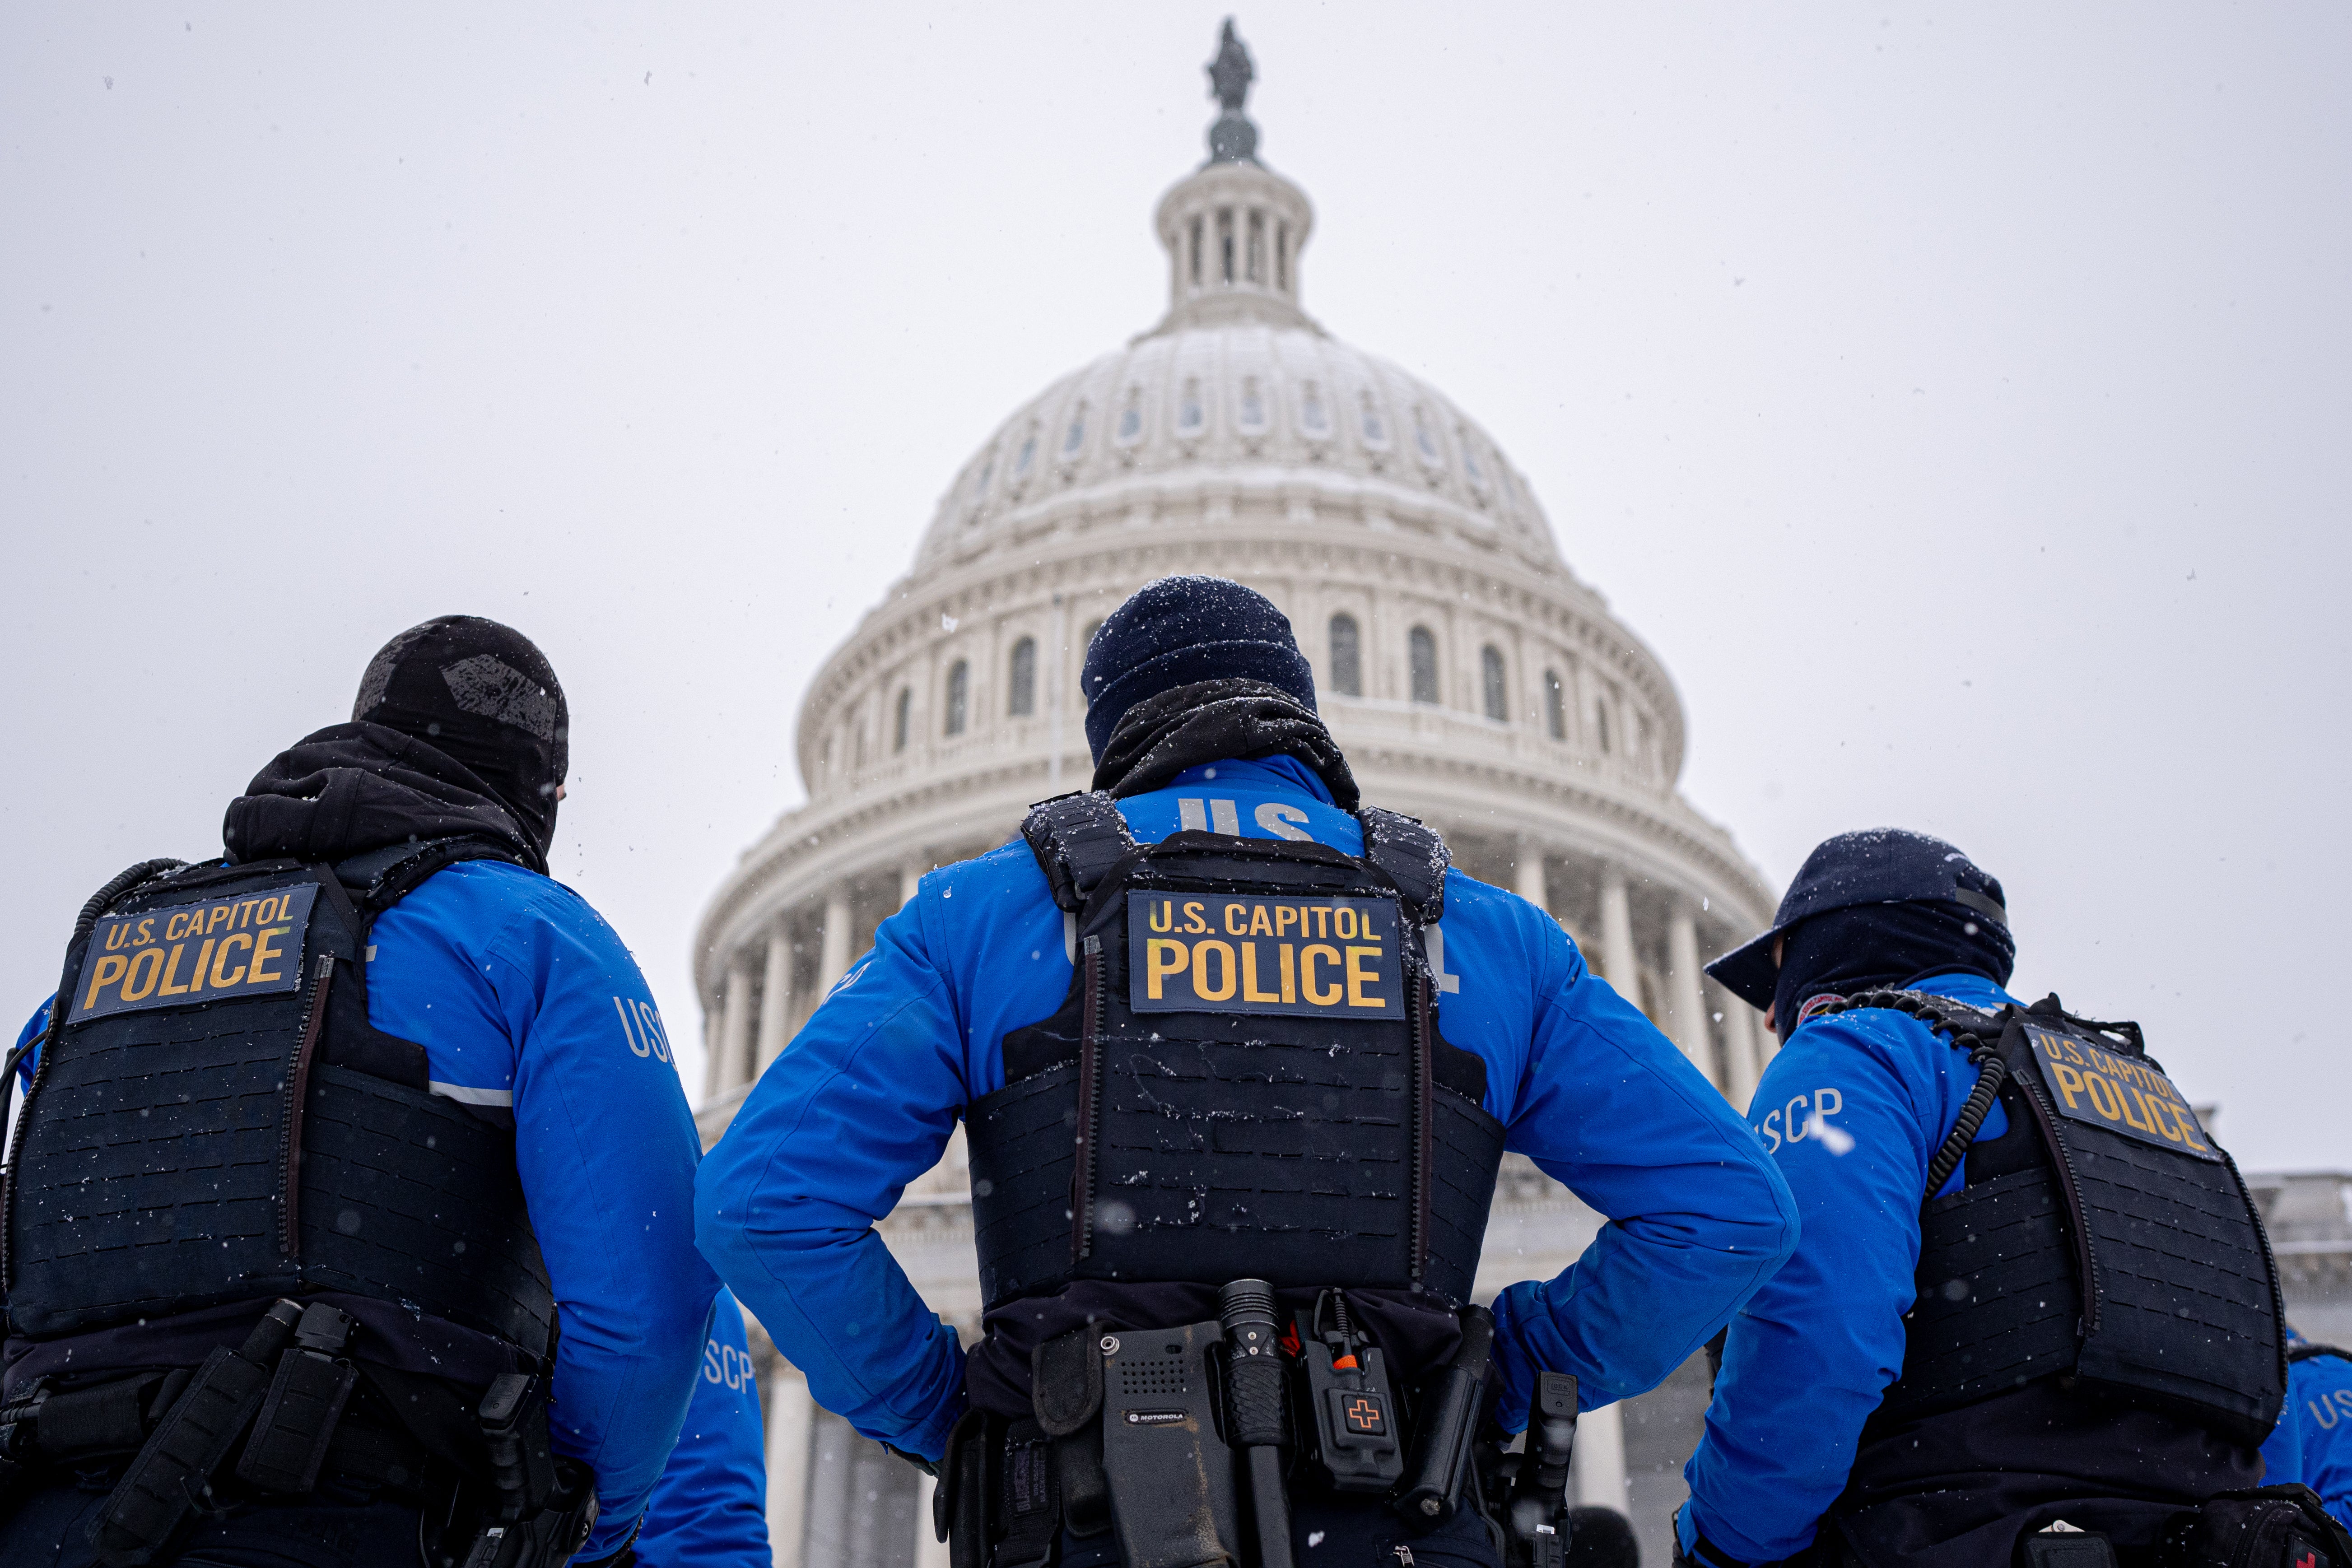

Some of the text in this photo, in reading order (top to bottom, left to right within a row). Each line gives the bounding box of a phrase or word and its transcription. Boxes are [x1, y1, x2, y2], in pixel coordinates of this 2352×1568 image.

[106, 894, 293, 950] U.S. CAPITOL
[1150, 900, 1381, 940] U.S. CAPITOL
[84, 926, 290, 1010] POLICE
[1147, 938, 1386, 1008] POLICE
[2040, 1034, 2181, 1104] U.S. CAPITOL
[1754, 1088, 1842, 1155] SCP
[2050, 1061, 2208, 1152] POLICE
[704, 1339, 754, 1394] SCP
